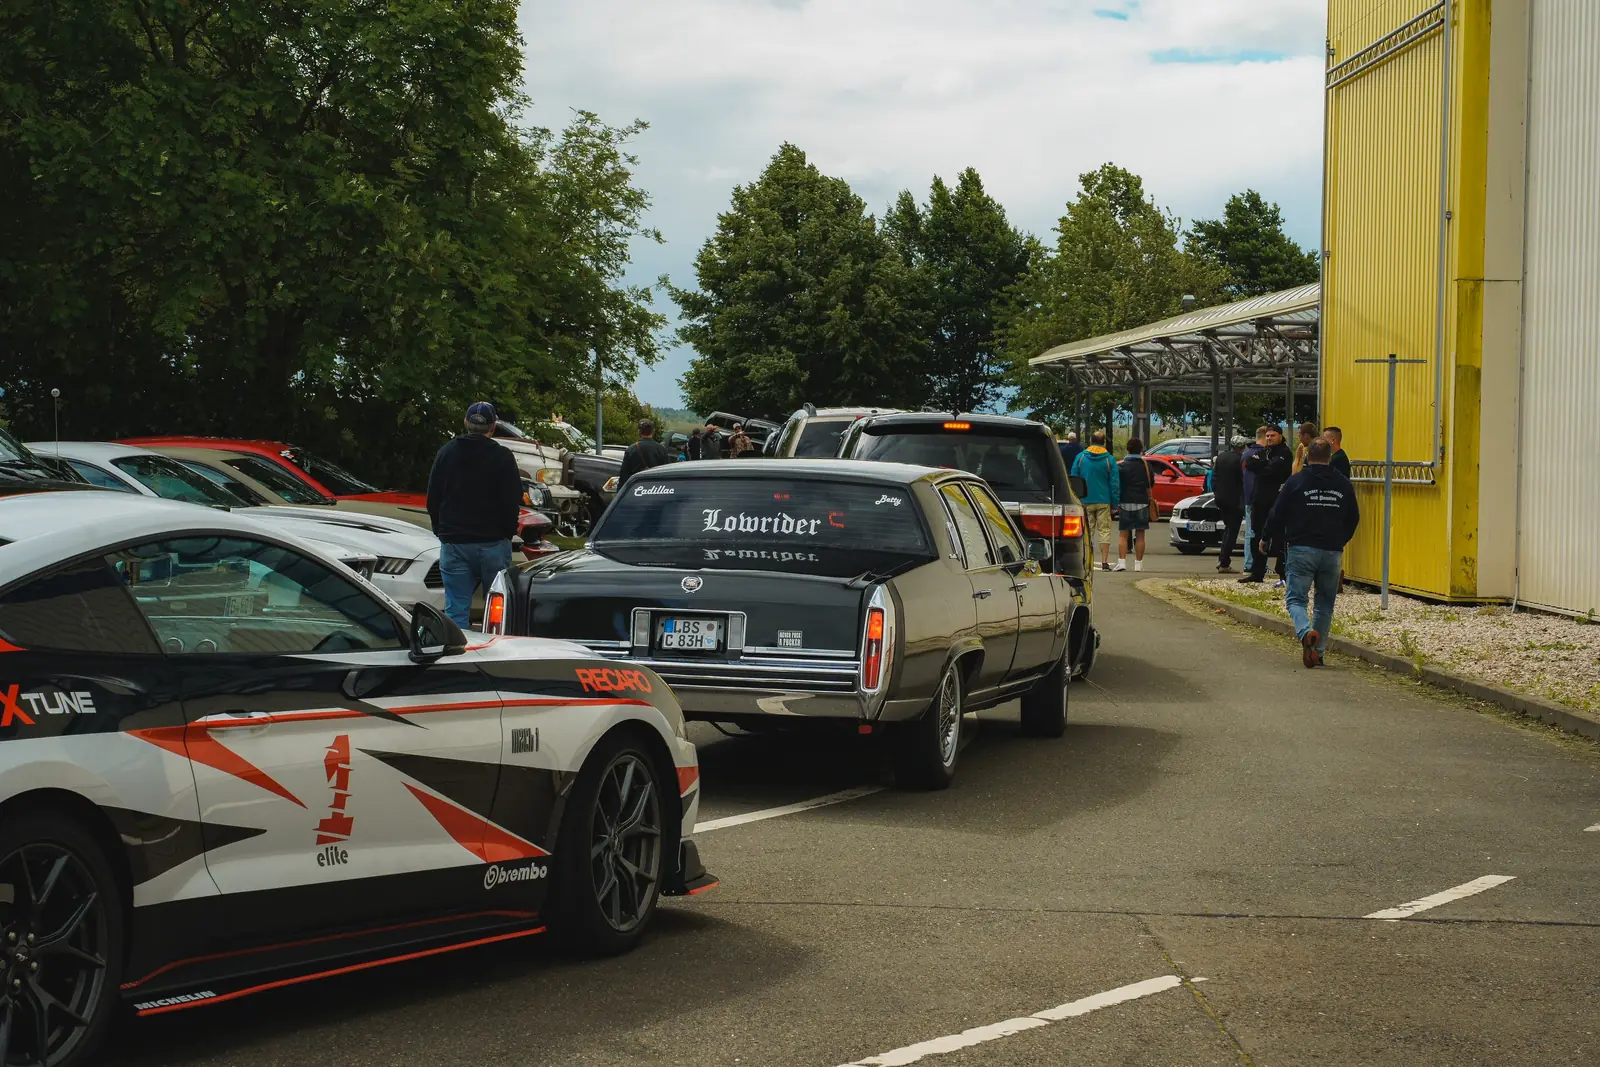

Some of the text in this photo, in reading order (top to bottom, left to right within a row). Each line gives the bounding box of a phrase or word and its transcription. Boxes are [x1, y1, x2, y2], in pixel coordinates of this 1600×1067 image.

[634, 485, 675, 496] Cadillac
[875, 494, 902, 507] Betty
[702, 509, 821, 535] Lowrider
[674, 621, 701, 634] LBS
[665, 634, 704, 648] C 83H
[575, 668, 652, 693] RECARO
[316, 846, 349, 867] elite
[498, 862, 548, 884] brembo
[134, 990, 217, 1010] MICHELIN
